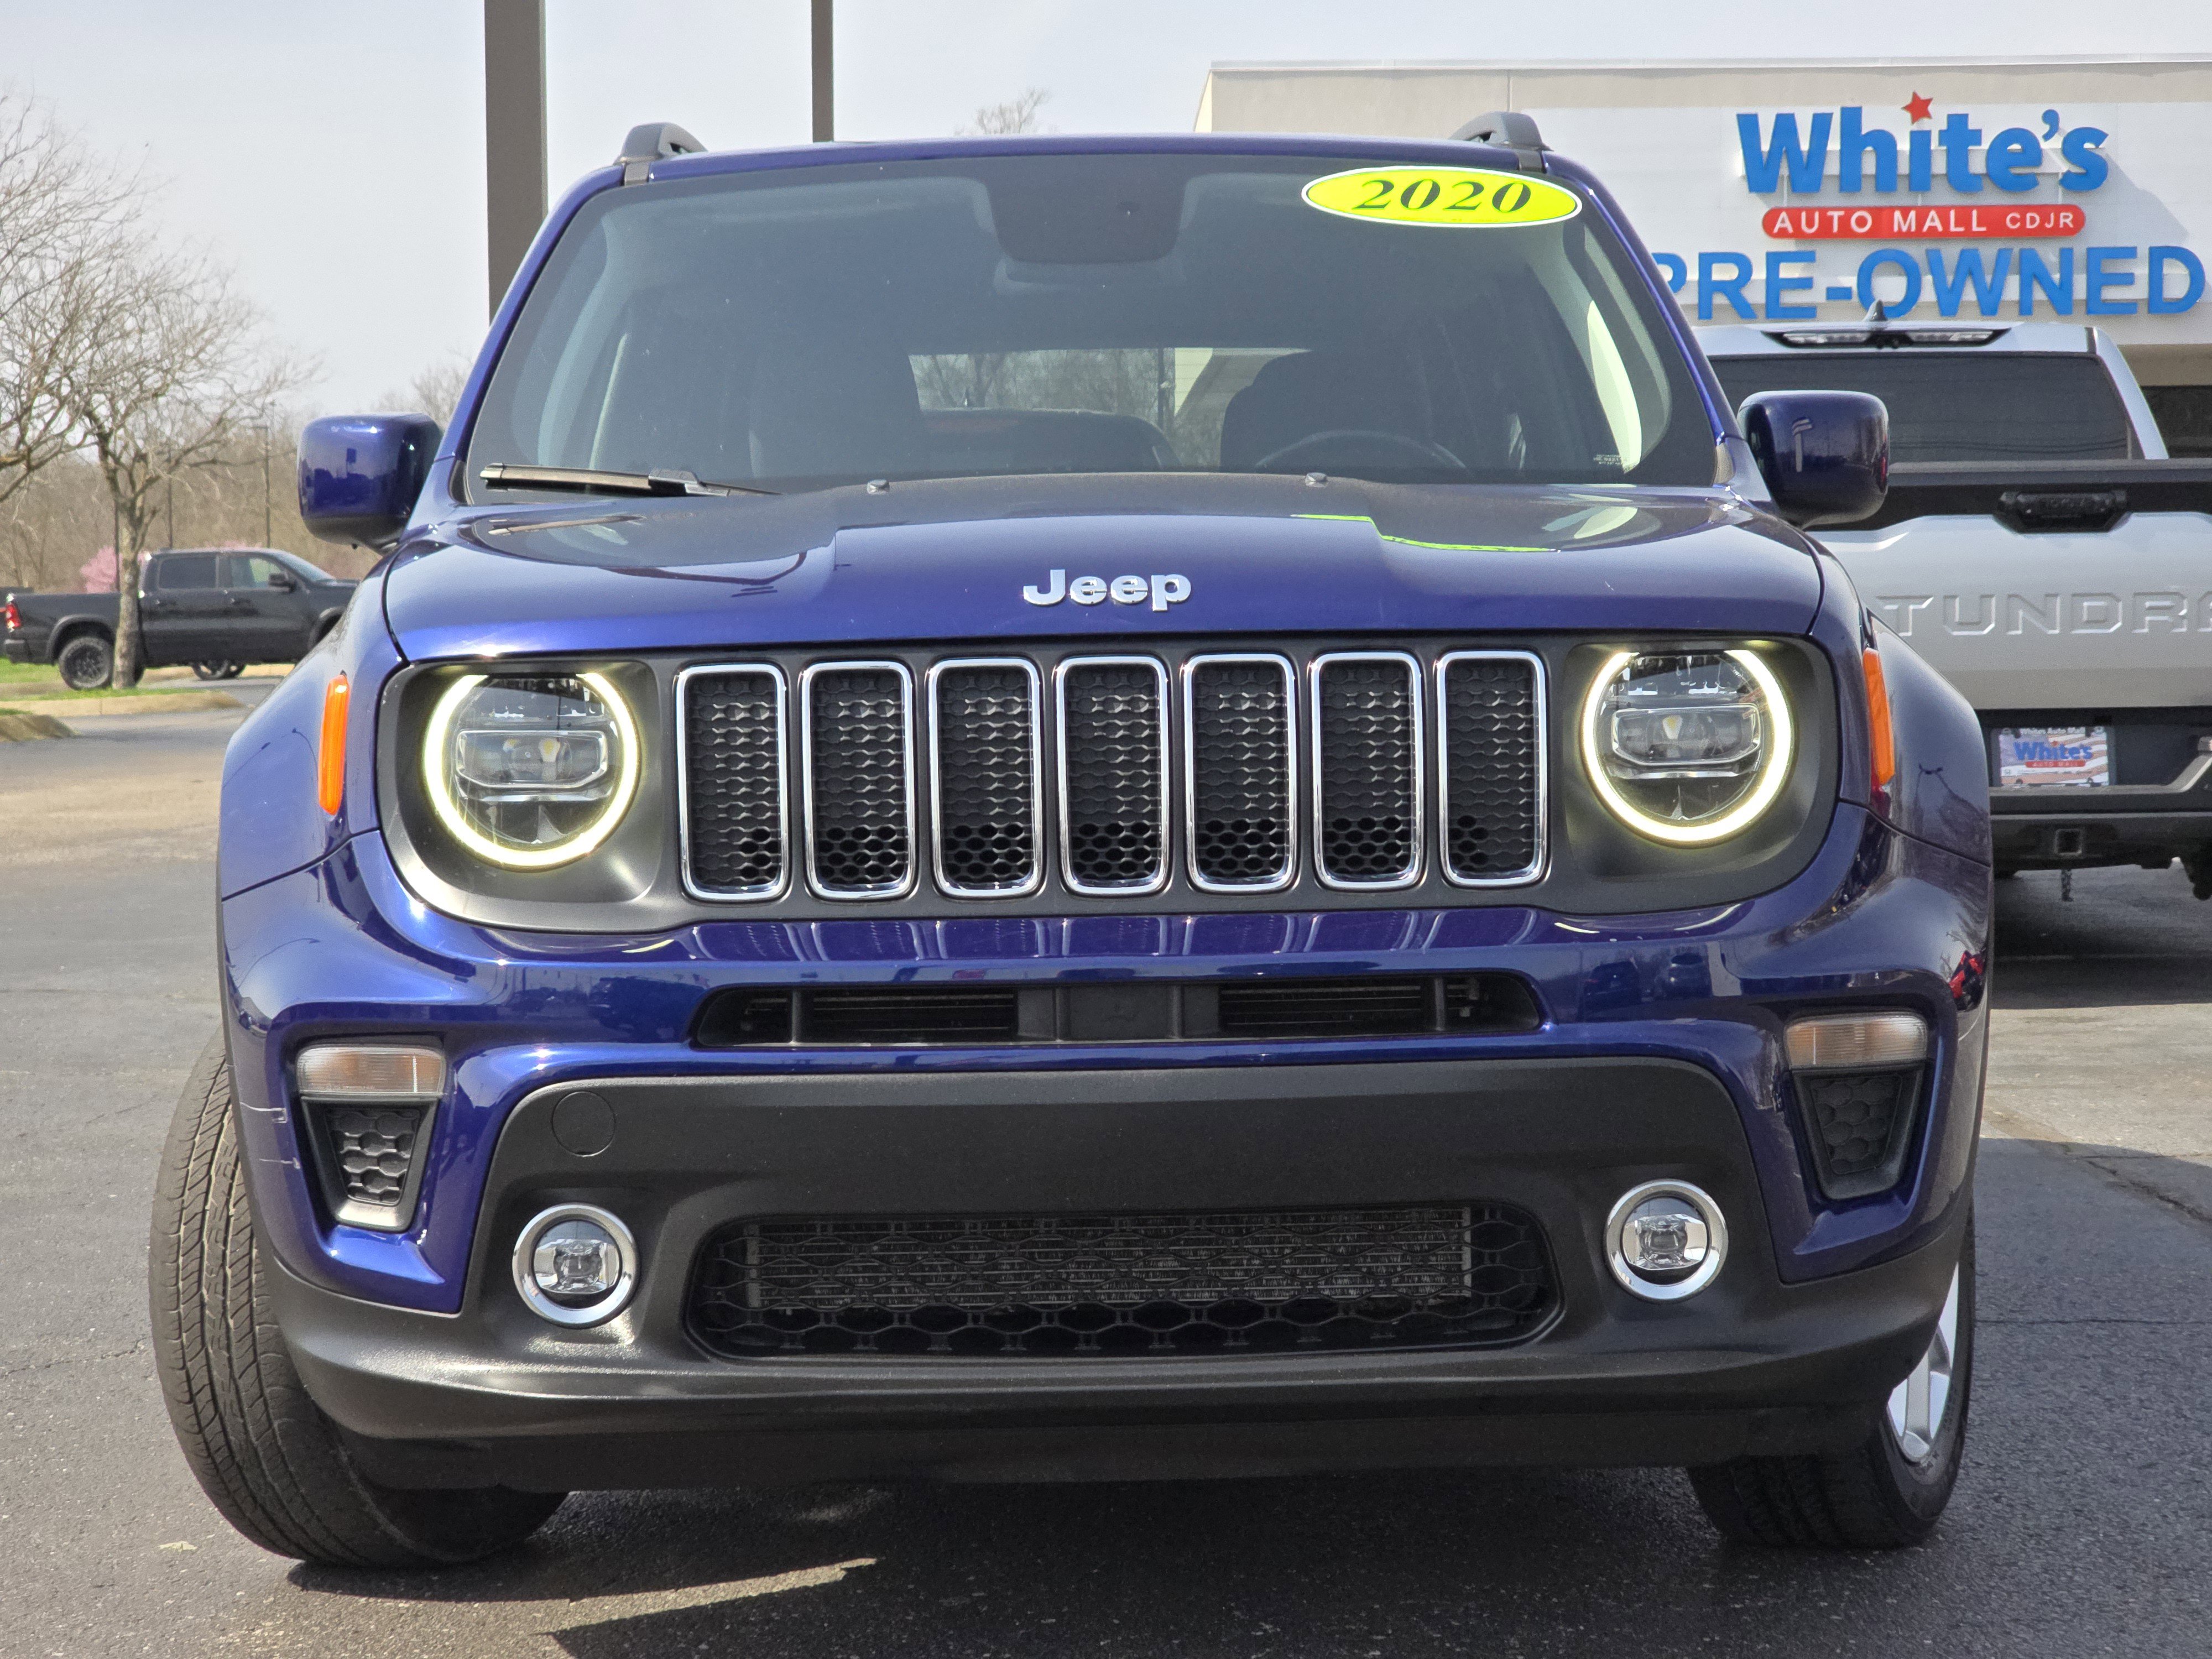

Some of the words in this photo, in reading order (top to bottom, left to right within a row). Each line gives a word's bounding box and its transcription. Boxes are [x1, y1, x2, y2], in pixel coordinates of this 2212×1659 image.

[1736, 91, 2109, 194] White's
[1352, 179, 1531, 212] 2020
[1773, 210, 1873, 234] AUTO
[1893, 209, 1987, 233] MALL
[2005, 212, 2074, 229] CDJR
[1022, 568, 1192, 612] Jeep
[1875, 591, 2212, 636] TUNDR
[2013, 741, 2094, 760] White's
